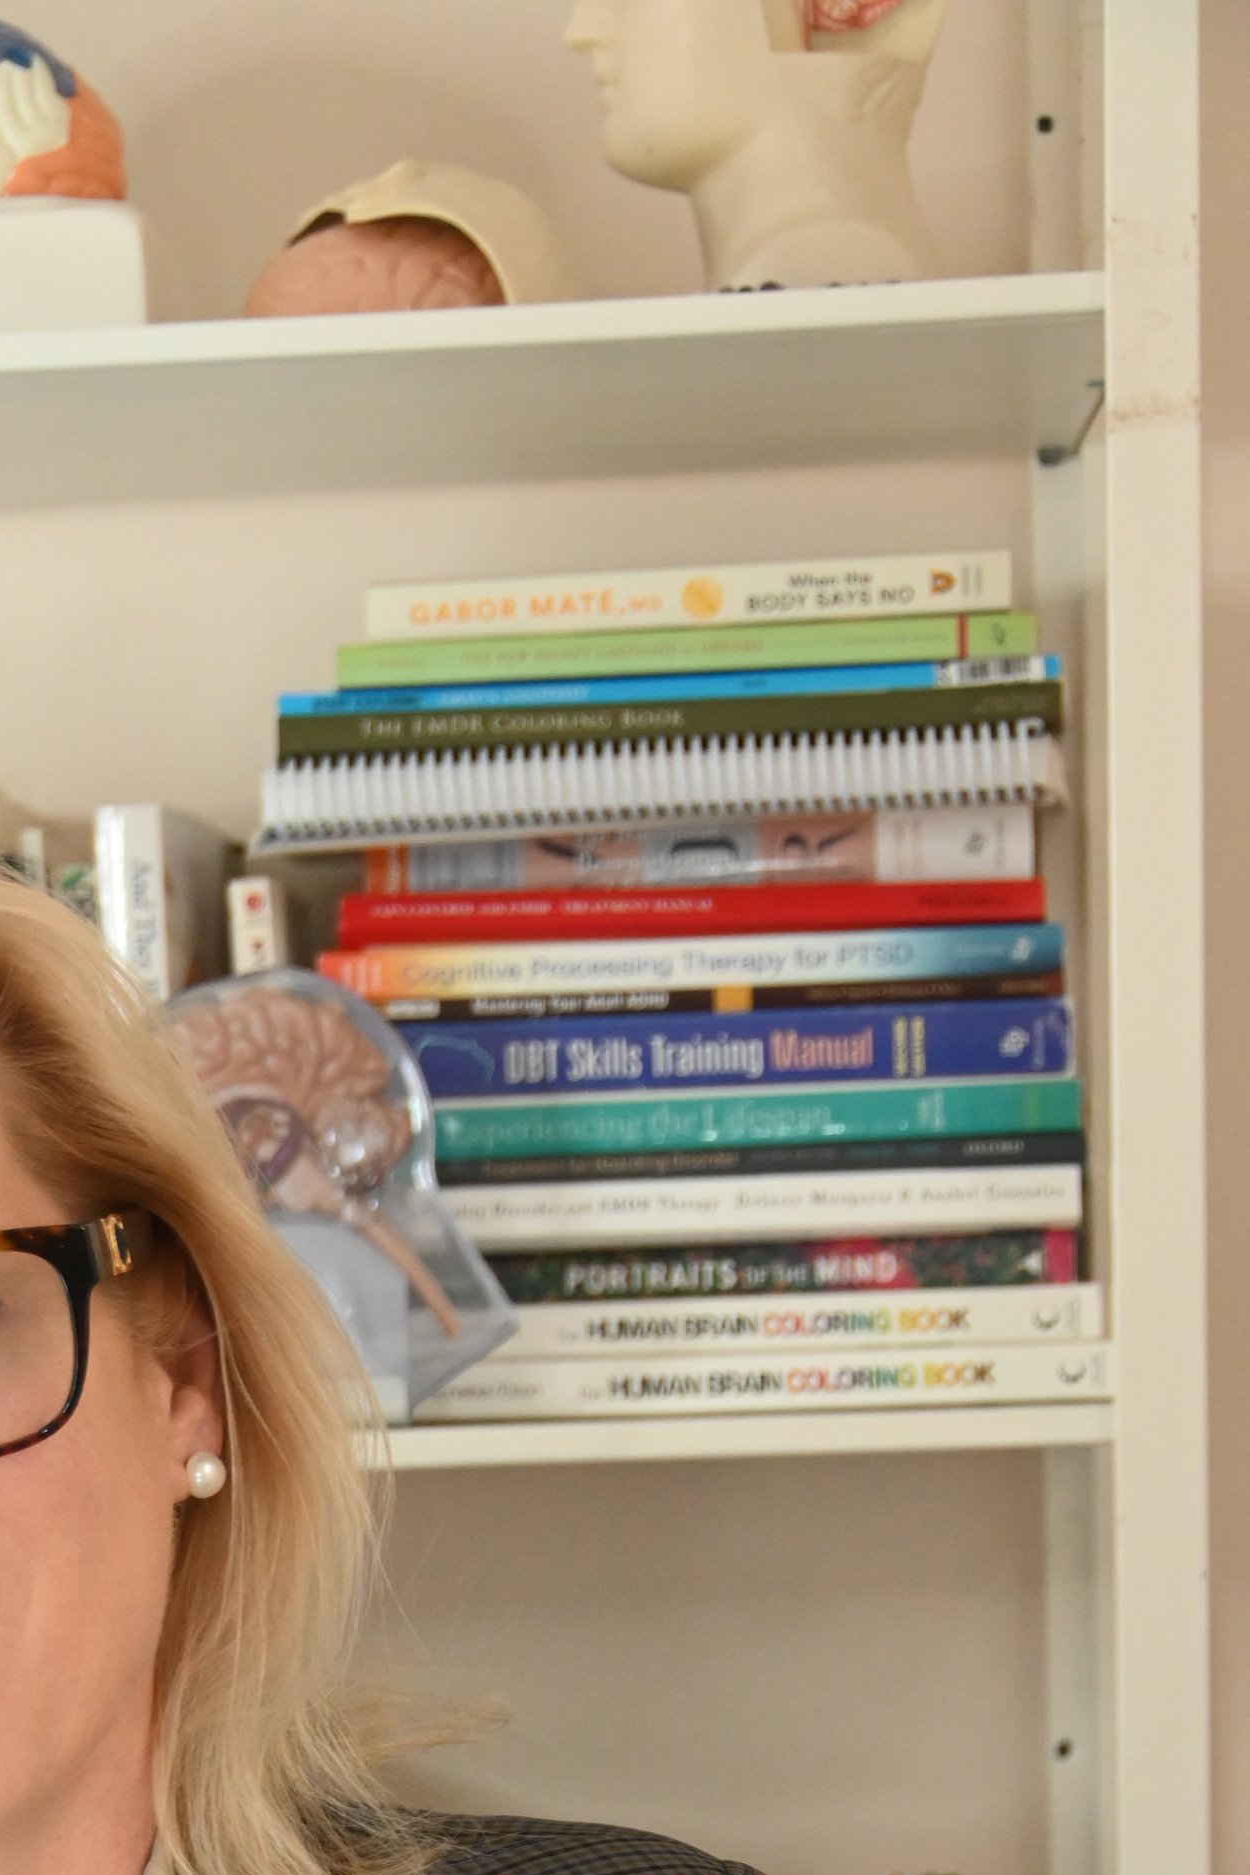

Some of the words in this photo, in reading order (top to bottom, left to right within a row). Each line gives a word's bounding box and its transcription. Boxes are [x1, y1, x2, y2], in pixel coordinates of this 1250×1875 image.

[790, 573, 835, 587] When
[846, 571, 872, 585] the
[409, 596, 517, 625] GABOR
[745, 592, 807, 614] BODY
[816, 589, 871, 608] SAYS
[881, 584, 915, 603] NO
[360, 717, 402, 738] THE
[412, 712, 485, 736] EMDR
[134, 859, 158, 910] And
[405, 962, 524, 988] Cognitive
[532, 954, 674, 982] Processing
[681, 947, 787, 973] Therapy
[794, 945, 831, 967] for
[837, 941, 915, 966] PTSD
[471, 997, 548, 1018] Mastering
[551, 994, 585, 1012] Your
[586, 992, 626, 1011] Adult
[627, 989, 670, 1010] ADHD
[503, 1038, 558, 1084] DBT
[566, 1036, 643, 1081] Skills
[649, 1032, 765, 1080] Training
[769, 1024, 873, 1072] Manual
[651, 1105, 699, 1141] the
[599, 1195, 651, 1213] EMDR
[658, 1193, 721, 1213] Therapy
[562, 1259, 738, 1296] PORTRAITS
[813, 1252, 897, 1283] MIND
[587, 1317, 679, 1341] HUMAN
[684, 1313, 758, 1337] BRAIN
[762, 1309, 892, 1336] COLORING
[897, 1306, 970, 1331] BOOK
[608, 1374, 701, 1399] HUMAN
[707, 1371, 783, 1395] BRAIN
[787, 1367, 918, 1393] COLORING
[923, 1362, 996, 1387] BOOK
